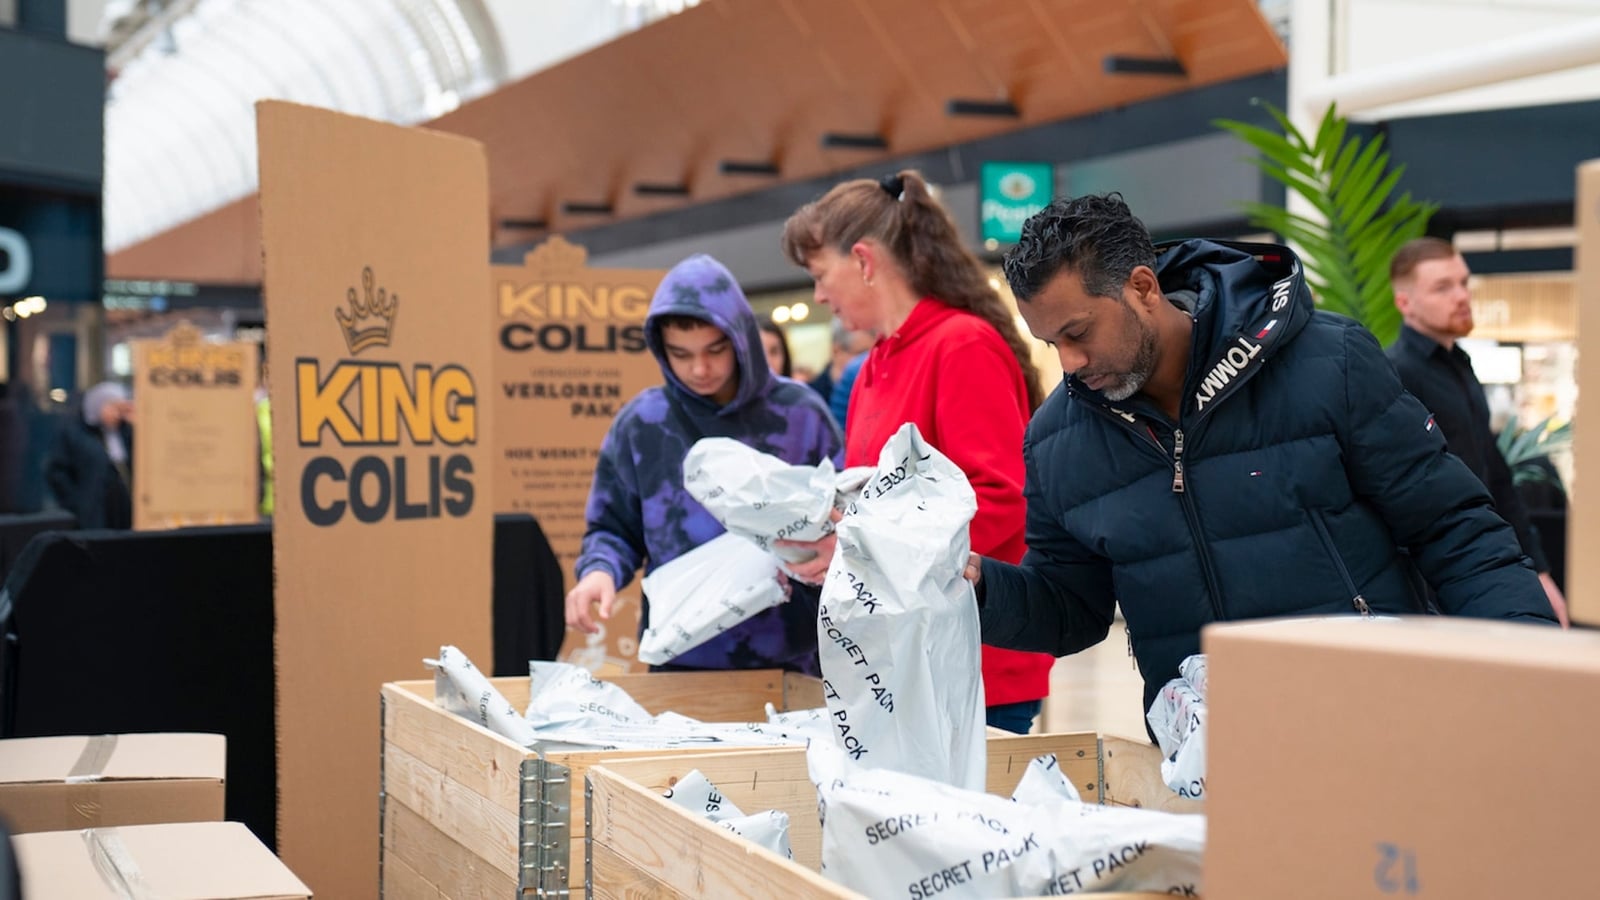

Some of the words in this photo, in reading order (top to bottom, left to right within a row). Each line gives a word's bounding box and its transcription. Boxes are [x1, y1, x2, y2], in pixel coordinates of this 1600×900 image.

[498, 282, 649, 320] KING
[500, 323, 646, 354] COLIS
[149, 368, 241, 388] COLIS
[502, 383, 620, 399] VERLOREN
[1195, 337, 1262, 411] TOMMY
[295, 357, 477, 447] KING
[570, 402, 618, 418] PAK
[301, 453, 475, 527] COLIS
[777, 515, 813, 540] PACK
[820, 605, 868, 667] SECRET
[834, 710, 868, 760] PACK
[1092, 840, 1152, 879] PACK
[909, 860, 973, 900] SECRET
